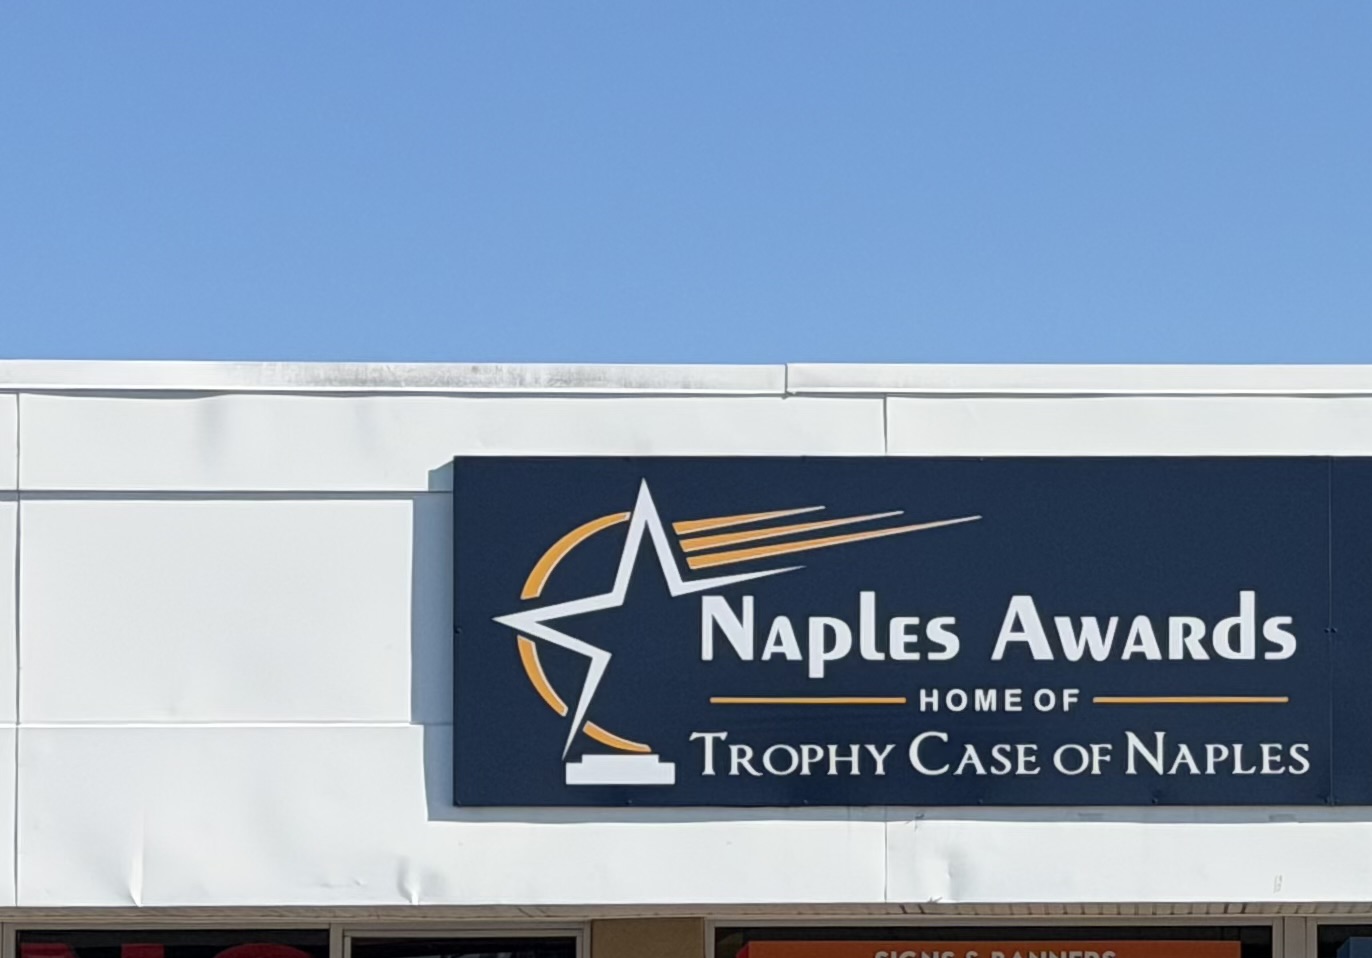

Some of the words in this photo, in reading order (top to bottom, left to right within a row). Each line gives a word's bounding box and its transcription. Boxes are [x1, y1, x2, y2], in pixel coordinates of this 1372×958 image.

[700, 590, 961, 680] Naples
[990, 590, 1297, 662] Awards
[919, 688, 1023, 712] HOME
[1033, 688, 1080, 712] OF
[689, 731, 896, 777] TROPHY
[908, 730, 1041, 776] CASE
[1052, 743, 1113, 776] OF
[1125, 730, 1310, 776] NAPLES
